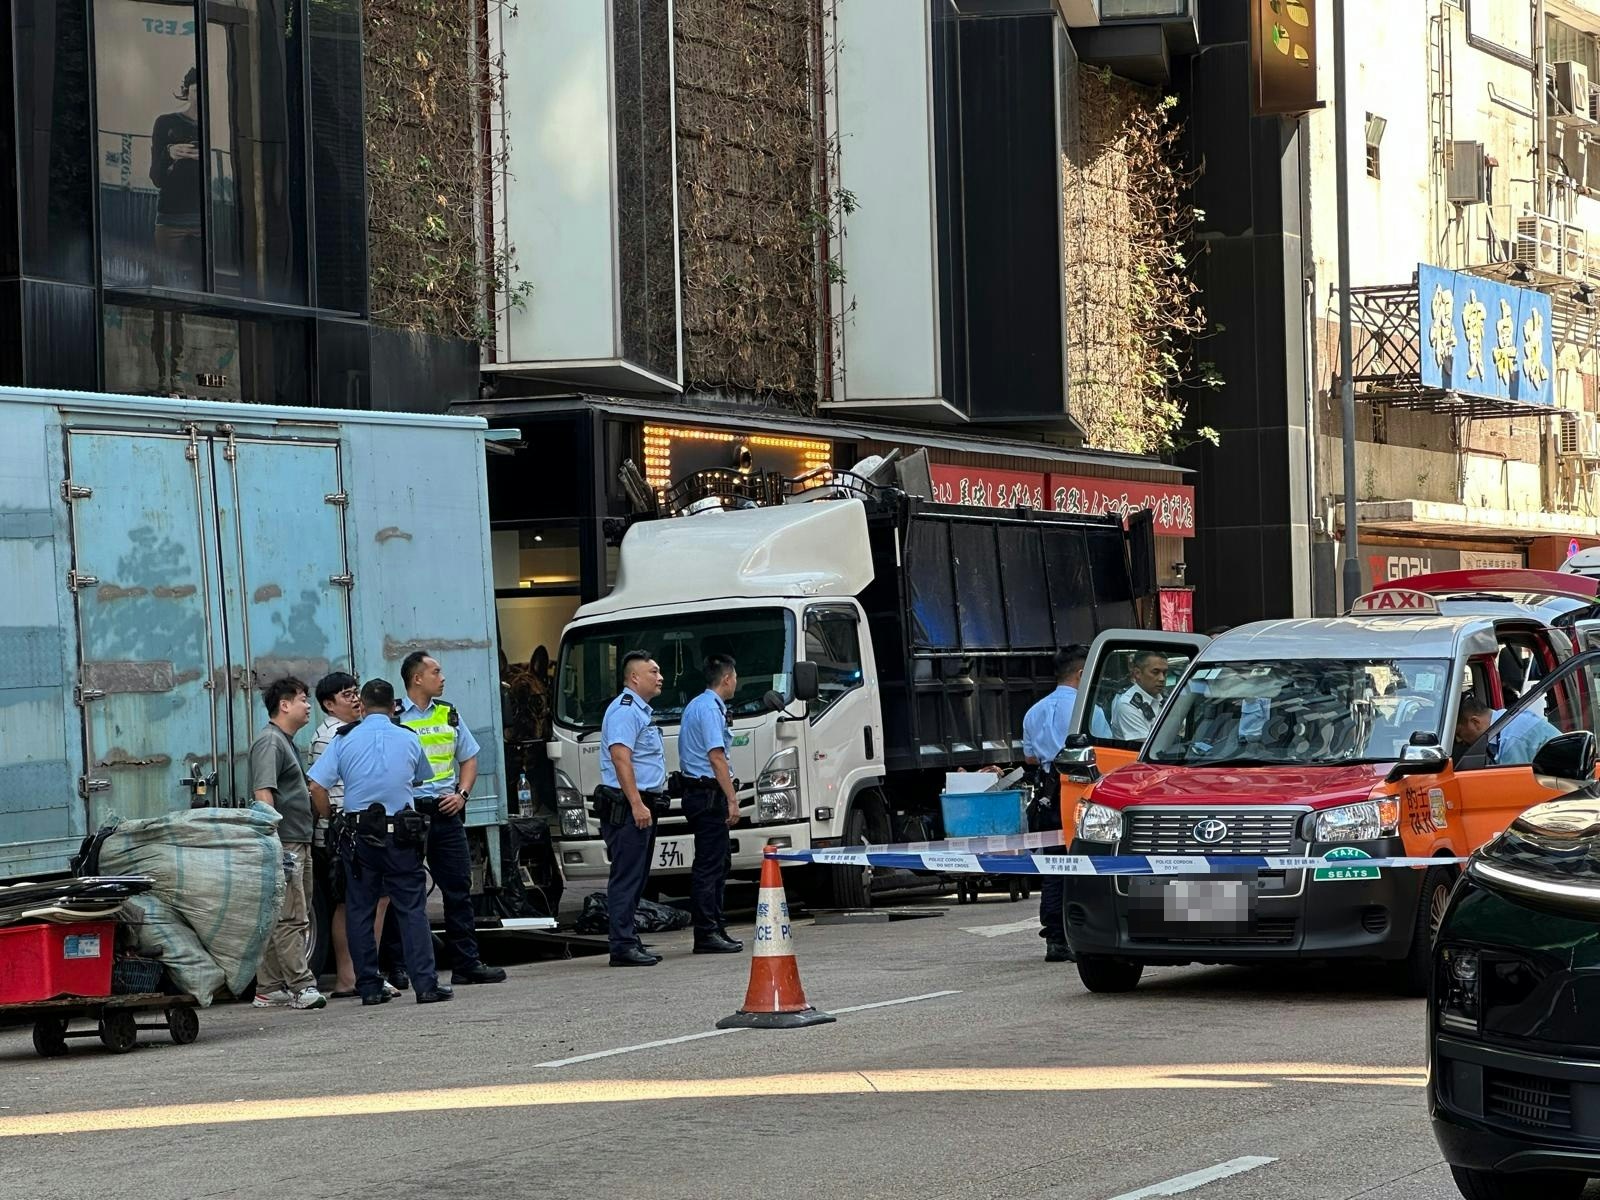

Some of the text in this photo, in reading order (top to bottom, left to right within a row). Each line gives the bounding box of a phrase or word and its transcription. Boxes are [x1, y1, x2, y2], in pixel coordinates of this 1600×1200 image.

[1362, 591, 1425, 610] TAXI
[1405, 786, 1428, 810] 的士
[1408, 811, 1438, 835] TAXI
[660, 841, 678, 856] ZZ
[1332, 849, 1359, 858] TAXI
[658, 851, 684, 867] 3711
[1328, 870, 1368, 879] SEATS
